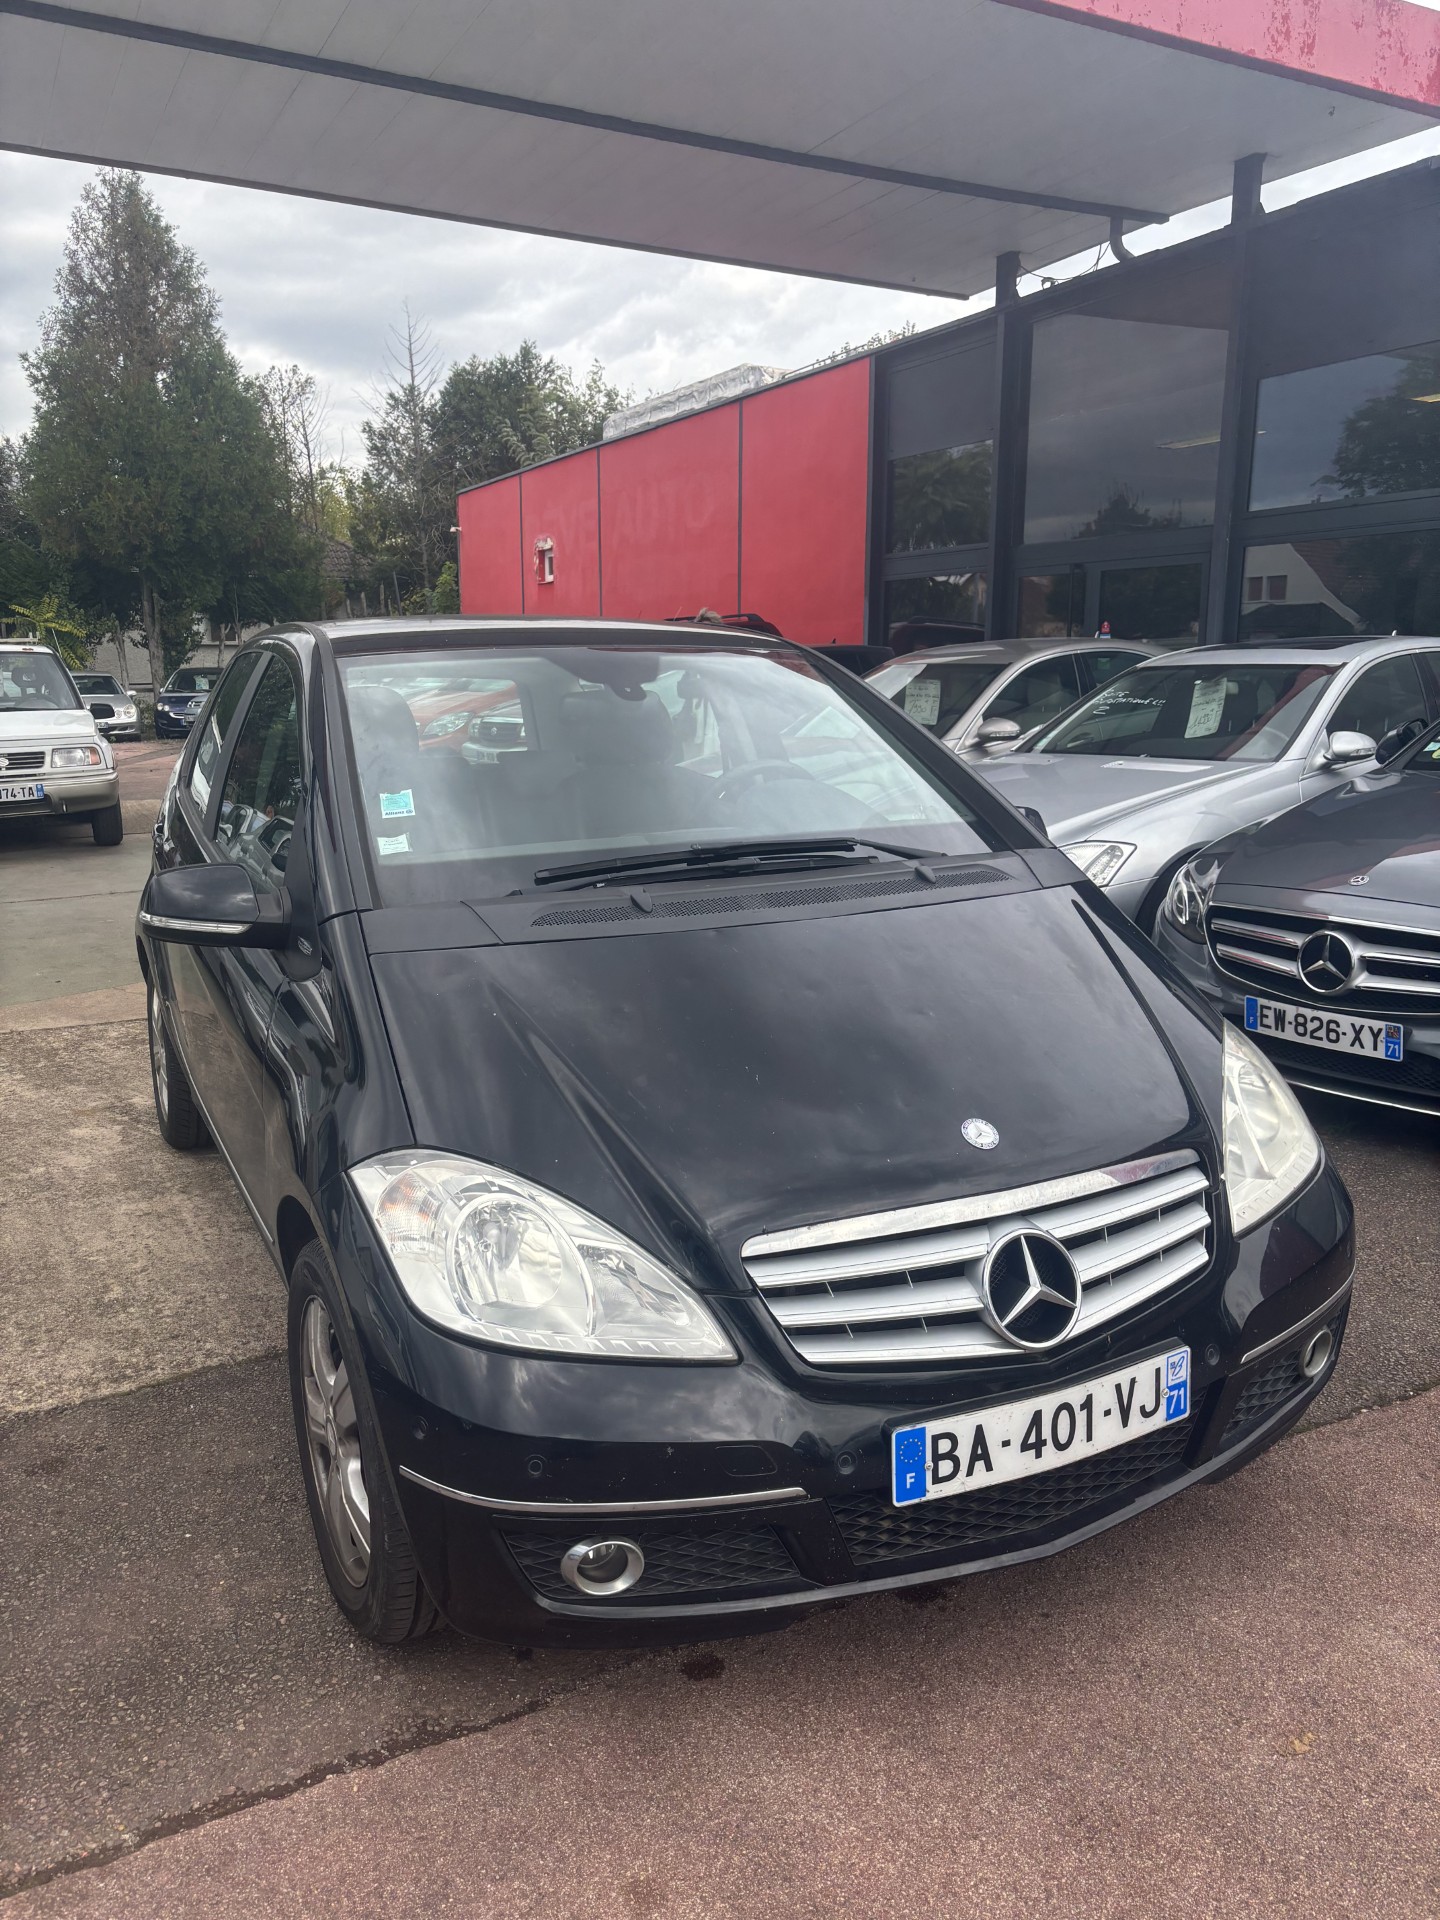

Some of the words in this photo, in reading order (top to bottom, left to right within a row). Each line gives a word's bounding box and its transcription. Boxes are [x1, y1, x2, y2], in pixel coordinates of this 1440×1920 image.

[0, 786, 35, 800] 74-TA
[1259, 1004, 1383, 1051] EW-826-XY
[1387, 1043, 1399, 1057] 71
[906, 1472, 916, 1489] F
[930, 1367, 1162, 1485] BA-401-VJ
[1169, 1387, 1185, 1414] 71
